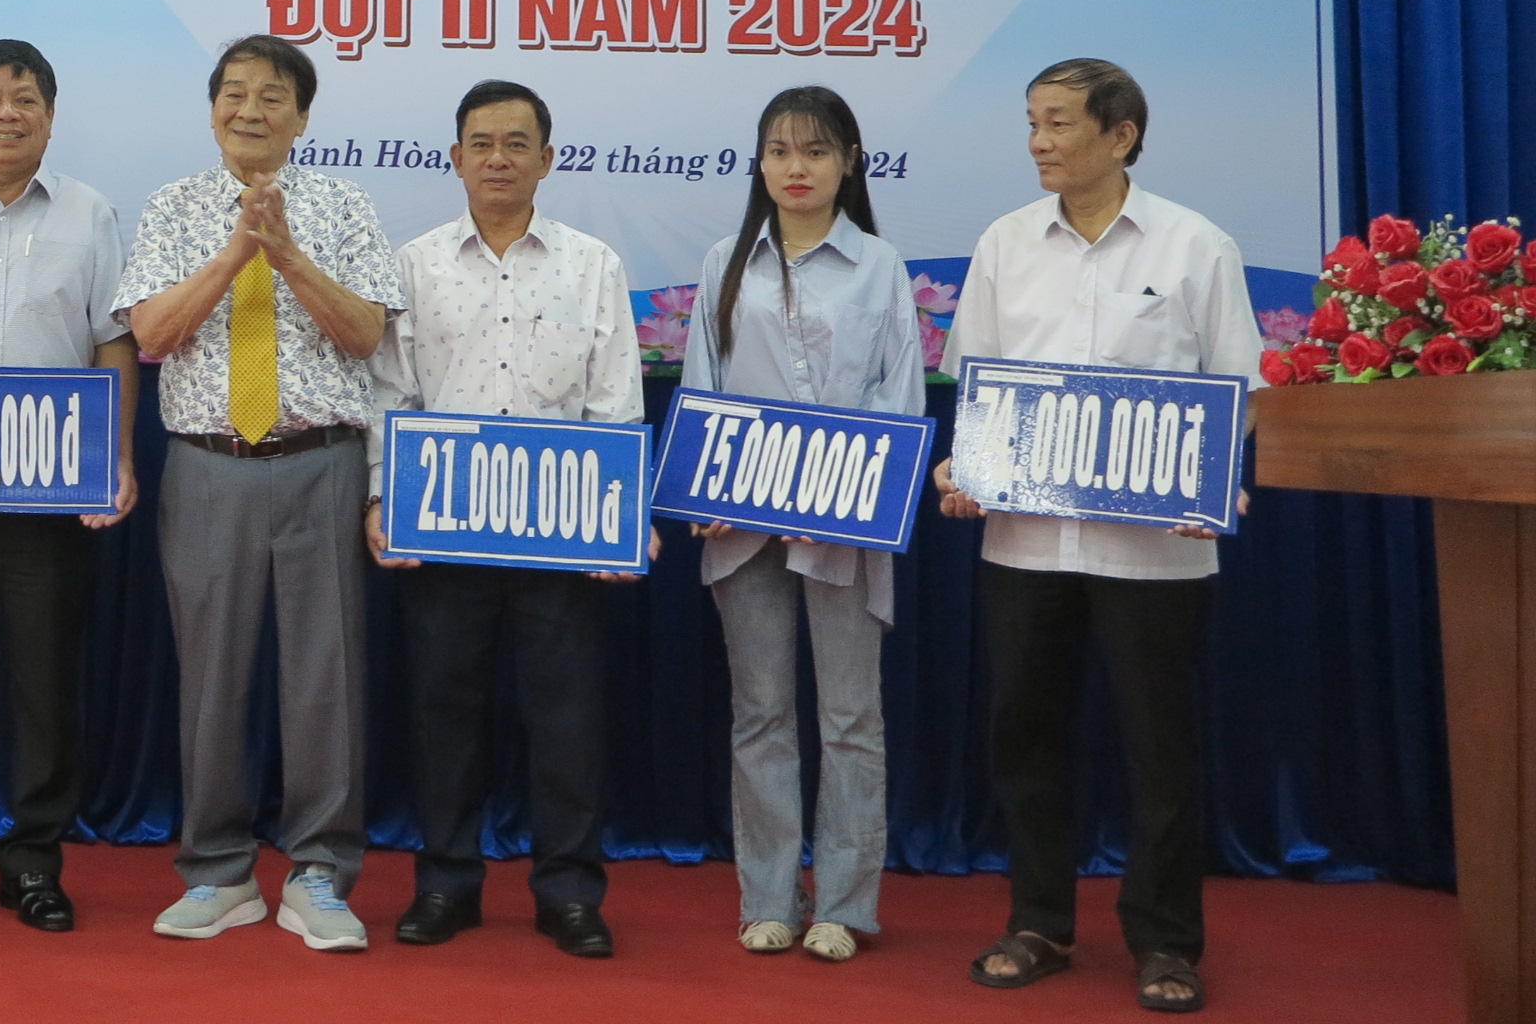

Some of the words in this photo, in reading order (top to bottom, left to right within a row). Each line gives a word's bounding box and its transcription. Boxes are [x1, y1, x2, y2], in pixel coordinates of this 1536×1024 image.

[289, 138, 363, 167] ánh
[373, 139, 452, 175] Hòa,
[555, 144, 596, 173] 22
[606, 145, 709, 182] tháng
[717, 148, 737, 176] 9
[417, 435, 623, 545] 21.000.000đ
